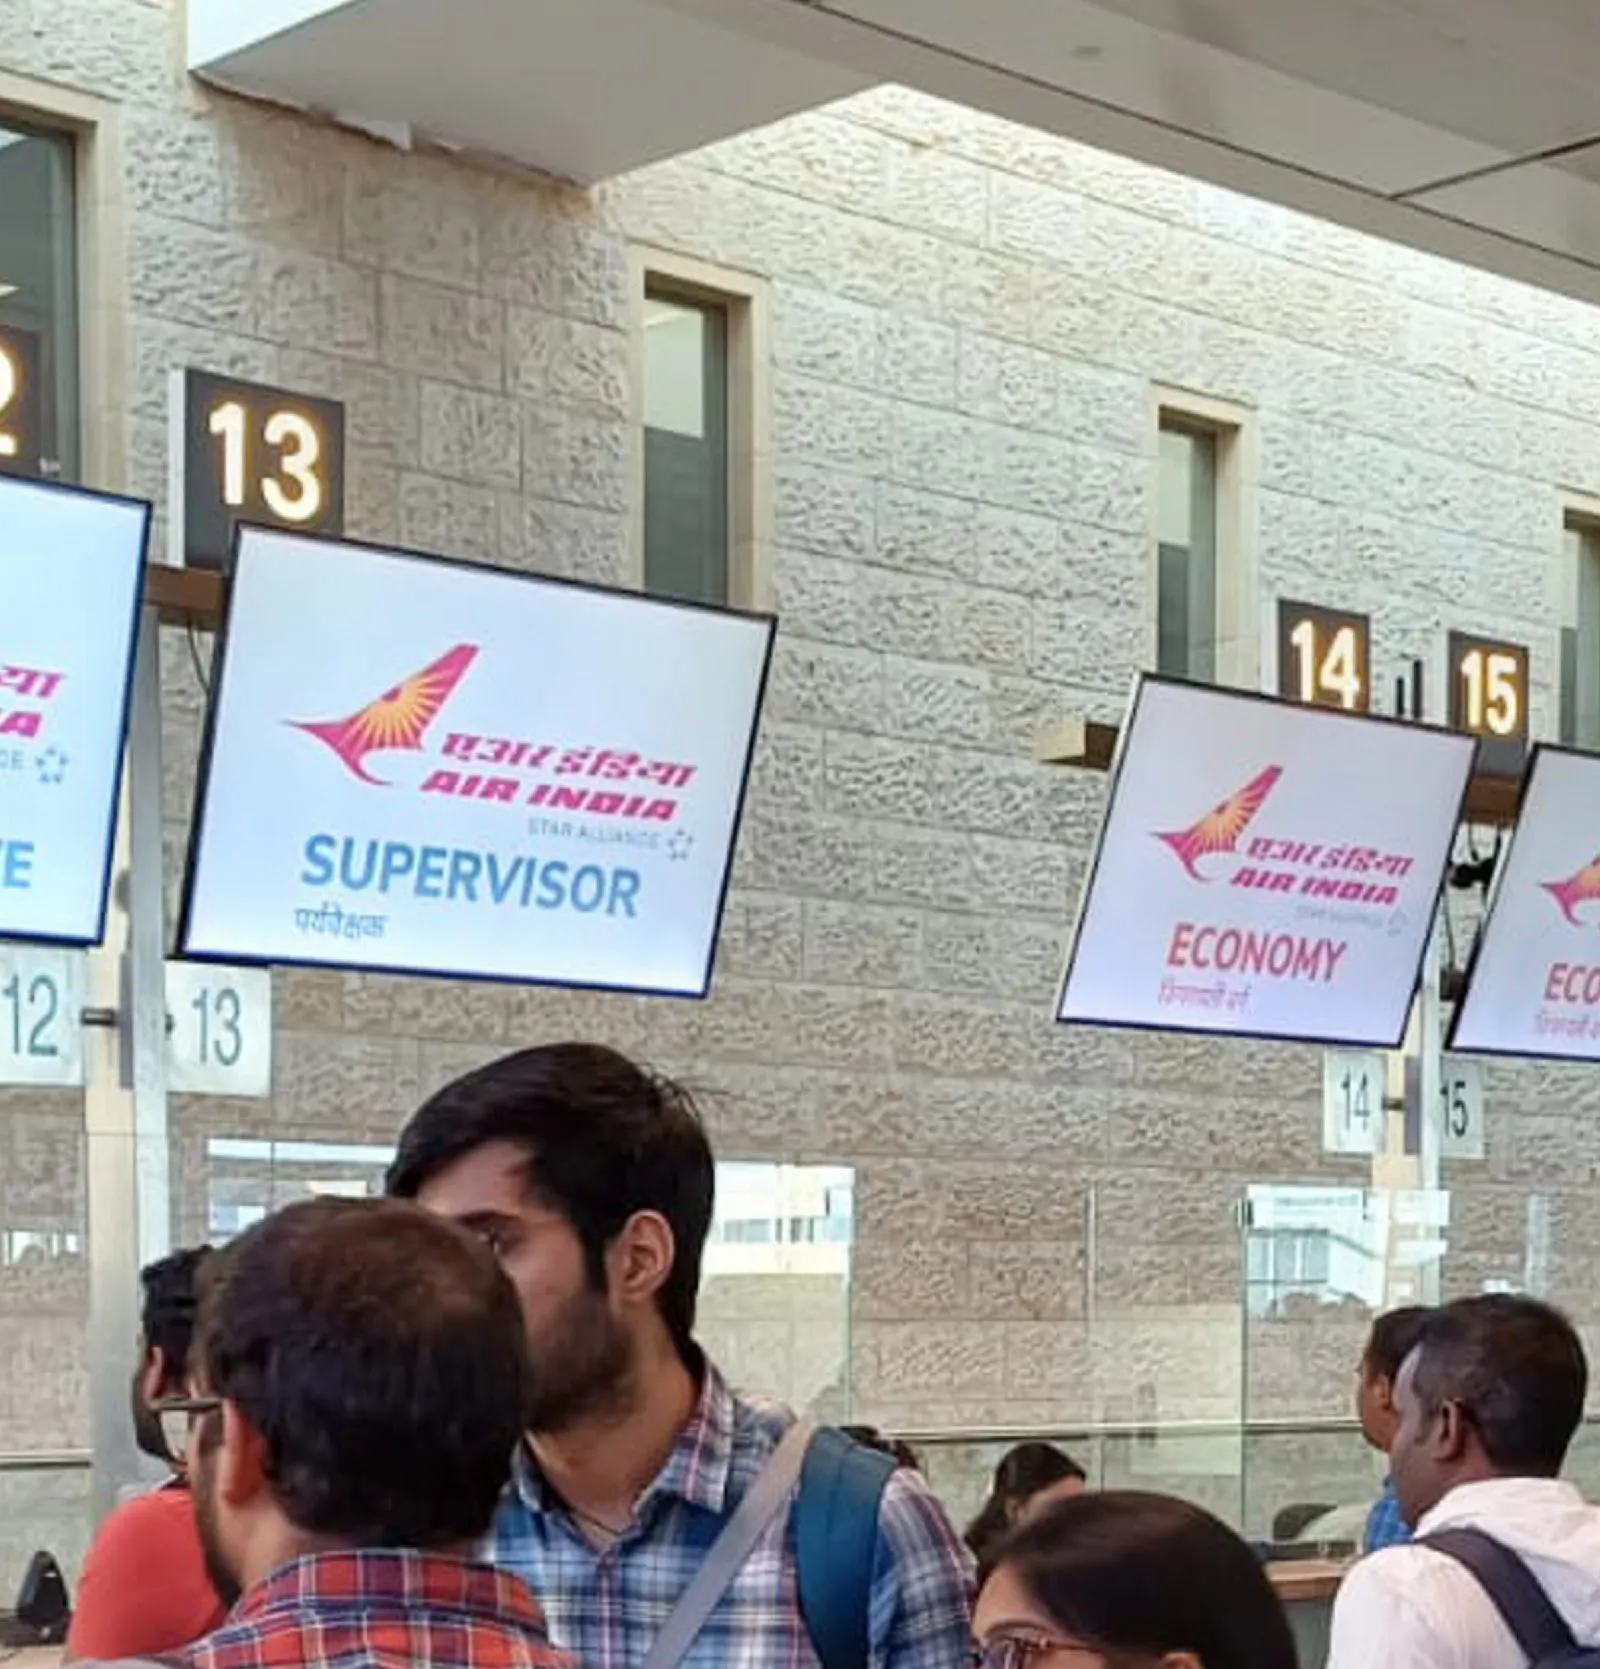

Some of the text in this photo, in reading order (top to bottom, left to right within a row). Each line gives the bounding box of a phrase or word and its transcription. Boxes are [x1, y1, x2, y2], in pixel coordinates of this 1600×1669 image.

[208, 401, 321, 521] 13
[1291, 620, 1360, 708] 14
[1461, 650, 1517, 735] 15
[420, 769, 678, 822] AIR INDIA
[528, 817, 573, 837] STAR
[300, 833, 642, 918] SUPERVISOR
[1230, 867, 1398, 905] AIR INDIA
[1167, 922, 1347, 983] ECONOMY
[2, 974, 58, 1057] 12
[191, 987, 242, 1066] 13
[1340, 1070, 1371, 1133] 14
[1440, 1081, 1469, 1138] 15
